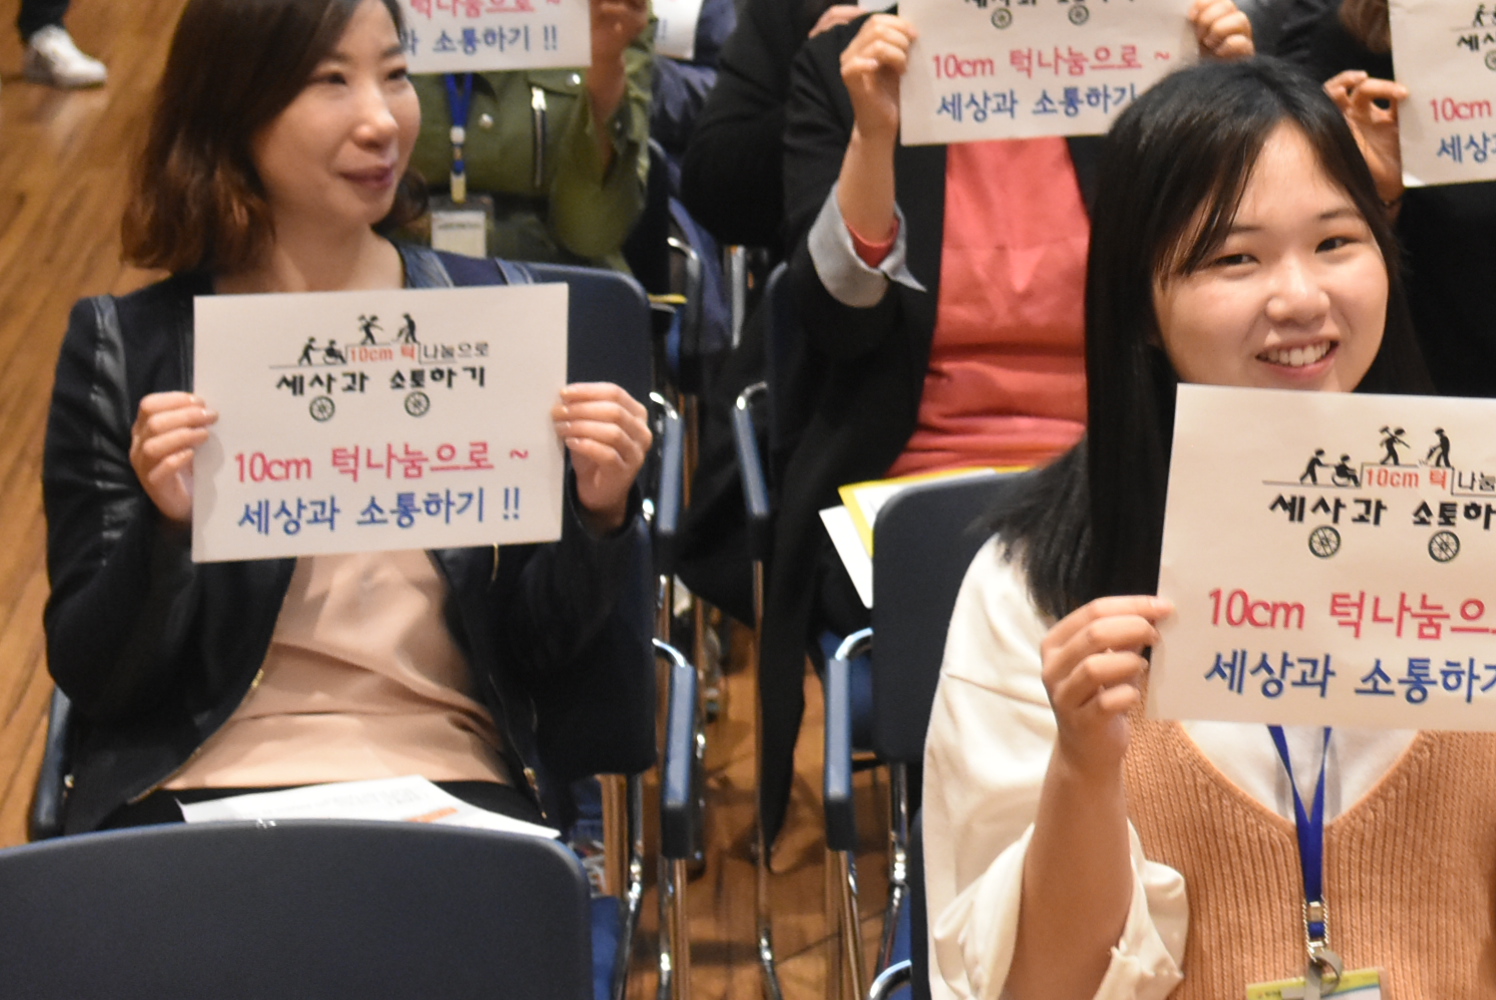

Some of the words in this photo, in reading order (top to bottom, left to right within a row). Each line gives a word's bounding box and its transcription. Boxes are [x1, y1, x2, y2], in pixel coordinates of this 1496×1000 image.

[432, 25, 531, 56] 소통하기
[932, 53, 995, 80] 10cm
[1009, 45, 1143, 79] 턱나눔으로
[937, 89, 1018, 123] 세상과
[1429, 97, 1493, 123] 10cm
[349, 346, 394, 363] 10cm
[235, 451, 313, 484] 10cm
[331, 441, 495, 483] 턱나눔으로
[1364, 468, 1420, 489] 10cm
[238, 495, 340, 536] 세상과
[356, 487, 485, 529] 소통하기
[1208, 587, 1305, 630] 10cm
[1204, 648, 1337, 699] 세상과
